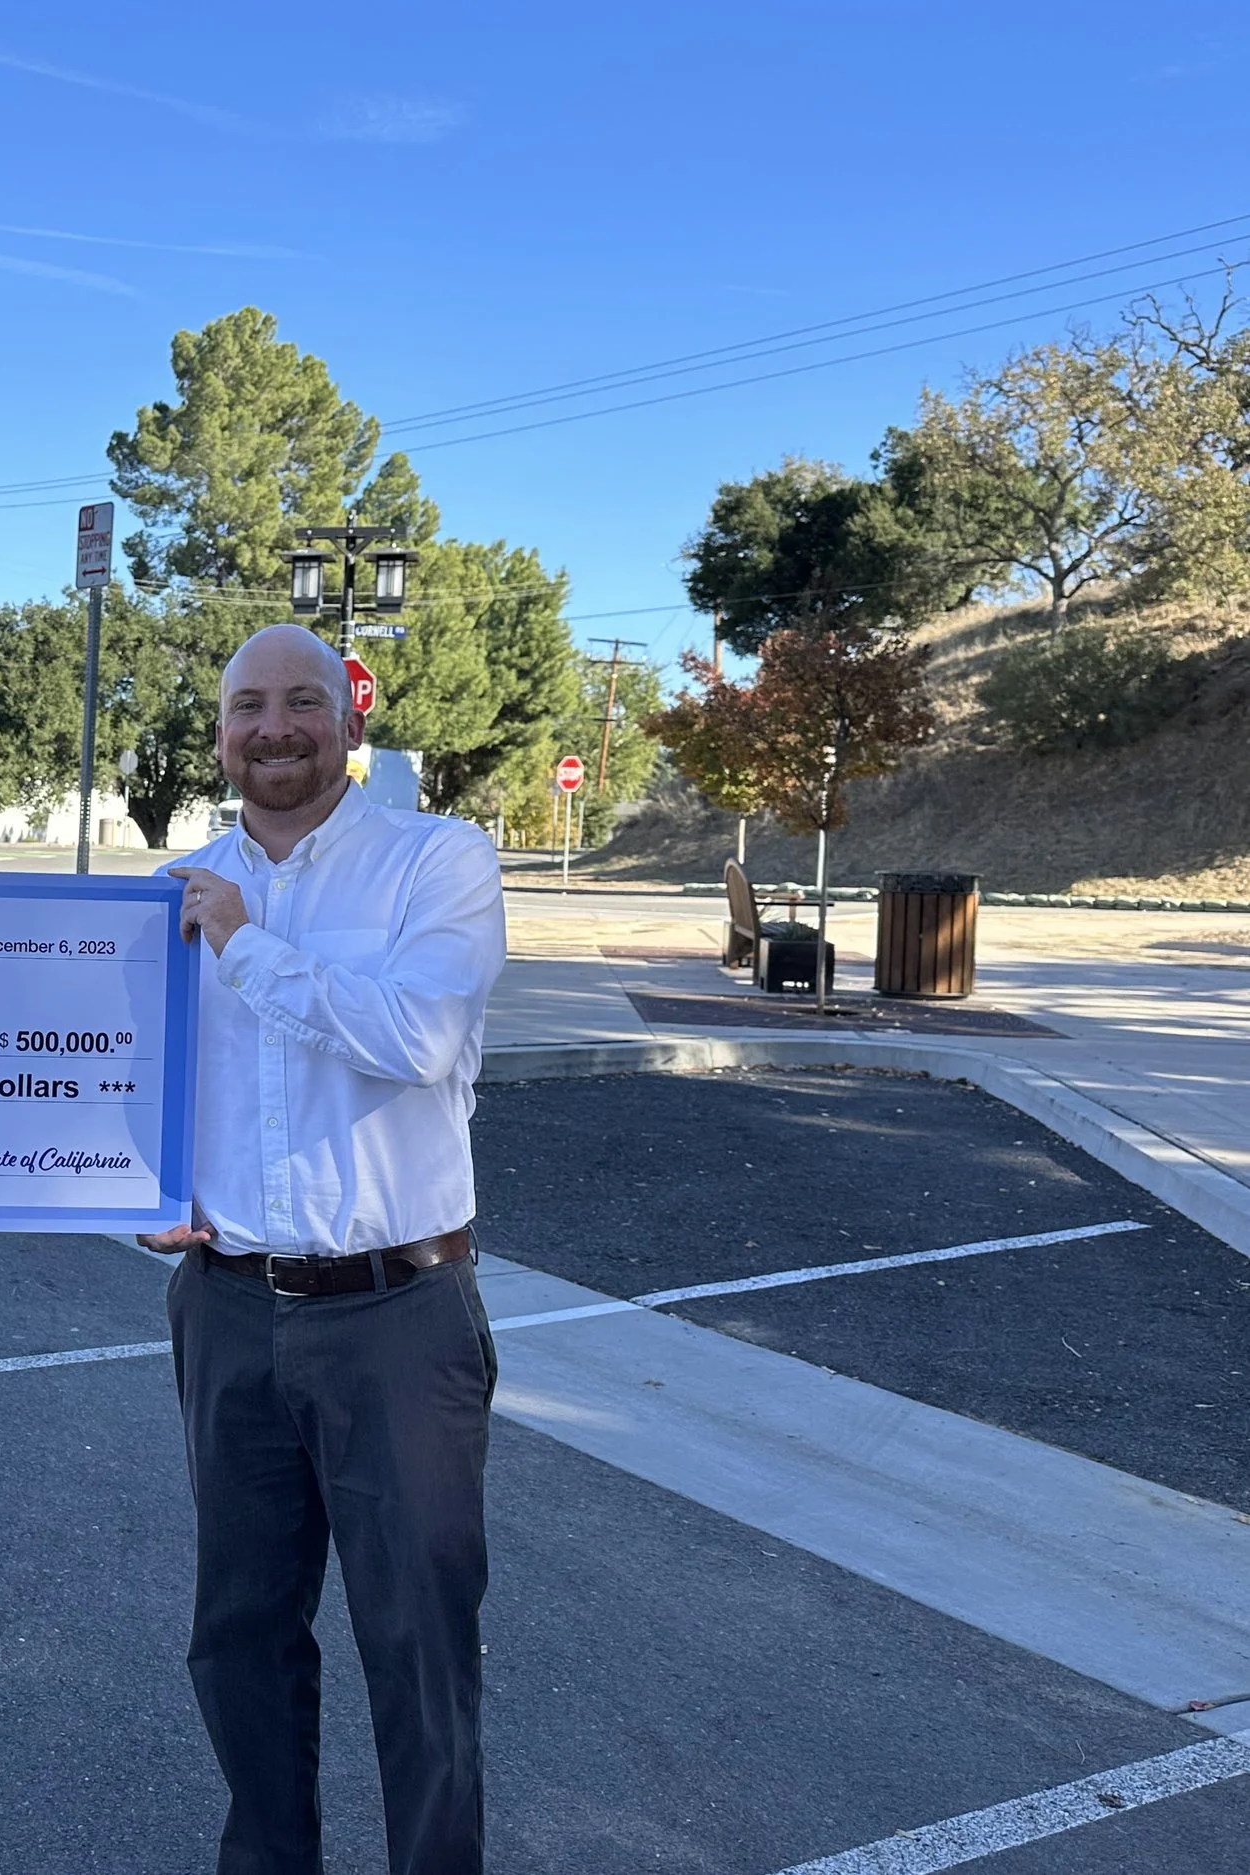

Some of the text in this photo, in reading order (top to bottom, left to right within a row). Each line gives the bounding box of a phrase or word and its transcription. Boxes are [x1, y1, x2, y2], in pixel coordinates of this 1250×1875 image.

[80, 508, 93, 529] NO
[79, 532, 110, 549] STOPPING
[355, 625, 395, 638] CORNELL
[59, 940, 73, 956] 6,
[78, 940, 116, 955] 2023
[0, 1032, 9, 1050] $
[20, 1150, 38, 1173] of
[39, 1148, 132, 1174] California
